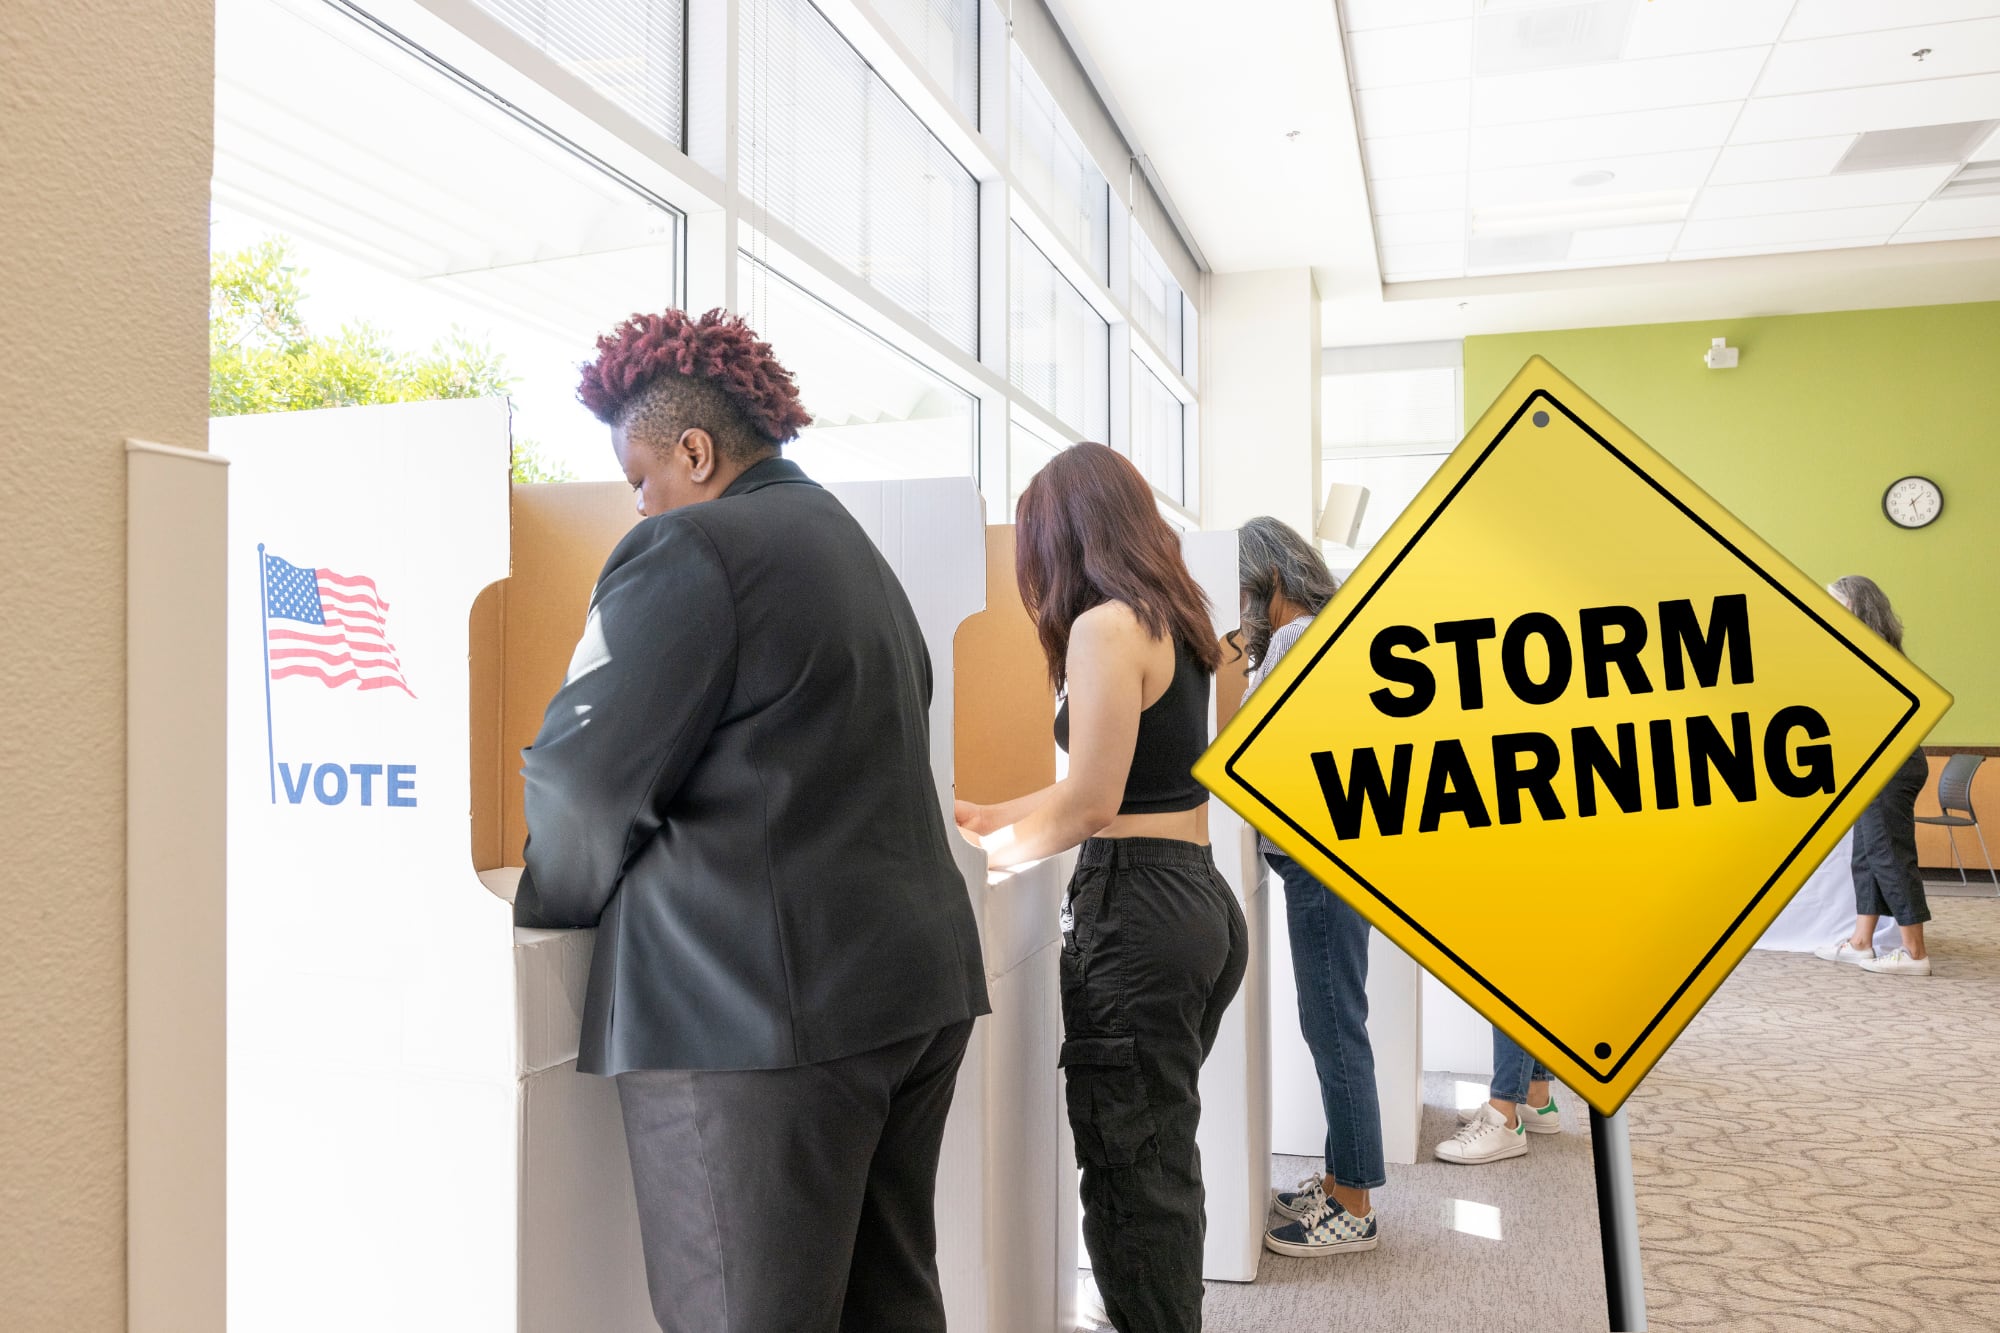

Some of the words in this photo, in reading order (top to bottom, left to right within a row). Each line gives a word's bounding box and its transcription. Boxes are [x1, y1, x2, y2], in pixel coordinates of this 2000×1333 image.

[1370, 594, 1755, 717] STORM
[278, 762, 417, 807] VOTE
[1311, 705, 1836, 841] WARNING
